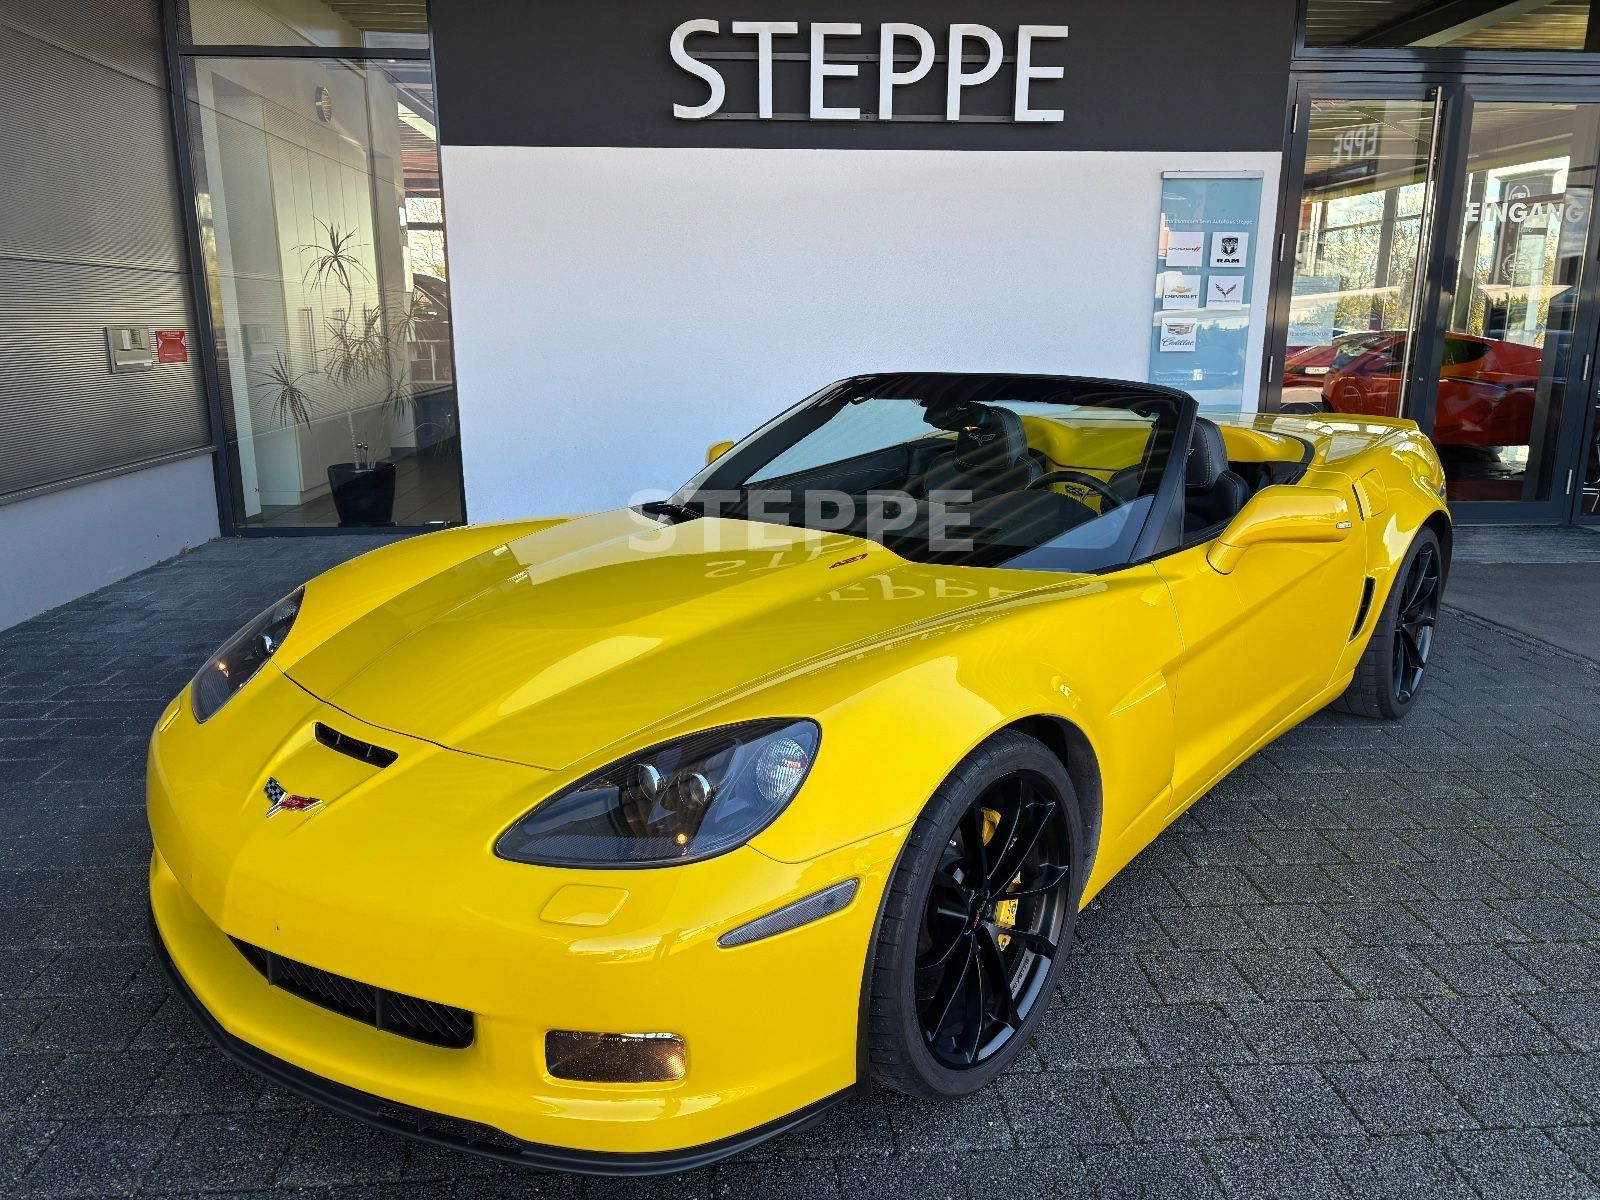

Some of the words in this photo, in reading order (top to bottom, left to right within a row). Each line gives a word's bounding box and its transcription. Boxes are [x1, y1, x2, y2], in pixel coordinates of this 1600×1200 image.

[669, 18, 1069, 122] STEPPE
[1467, 202, 1585, 223] EINGANG
[1161, 336, 1194, 346] Cadillac
